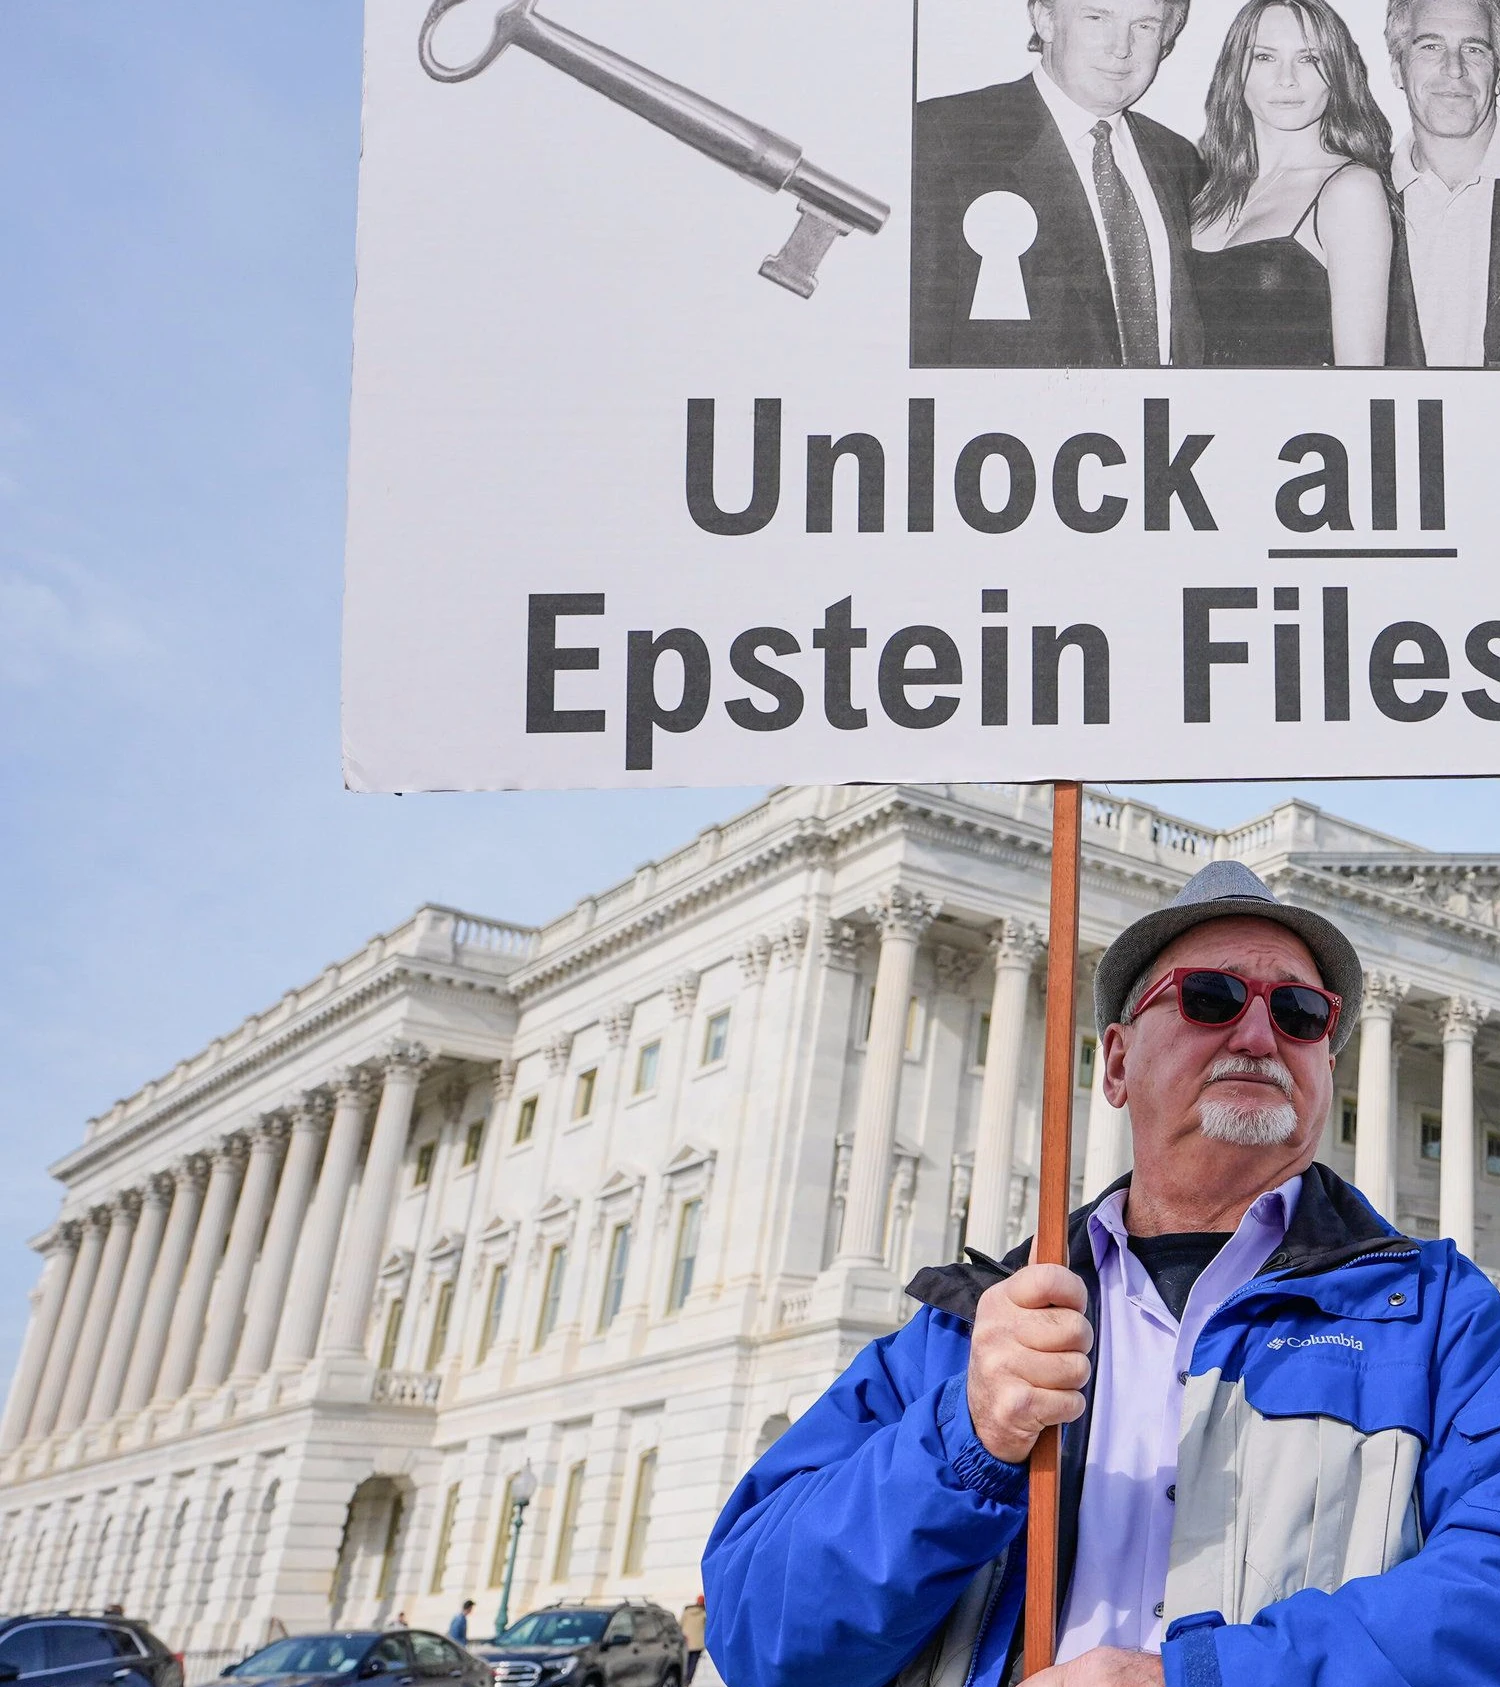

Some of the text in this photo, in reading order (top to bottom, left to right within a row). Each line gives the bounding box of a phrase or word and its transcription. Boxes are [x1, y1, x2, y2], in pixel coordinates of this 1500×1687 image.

[685, 397, 1446, 536] Unlock all
[525, 587, 1110, 771] Epstein
[1287, 1332, 1363, 1350] Columbia
